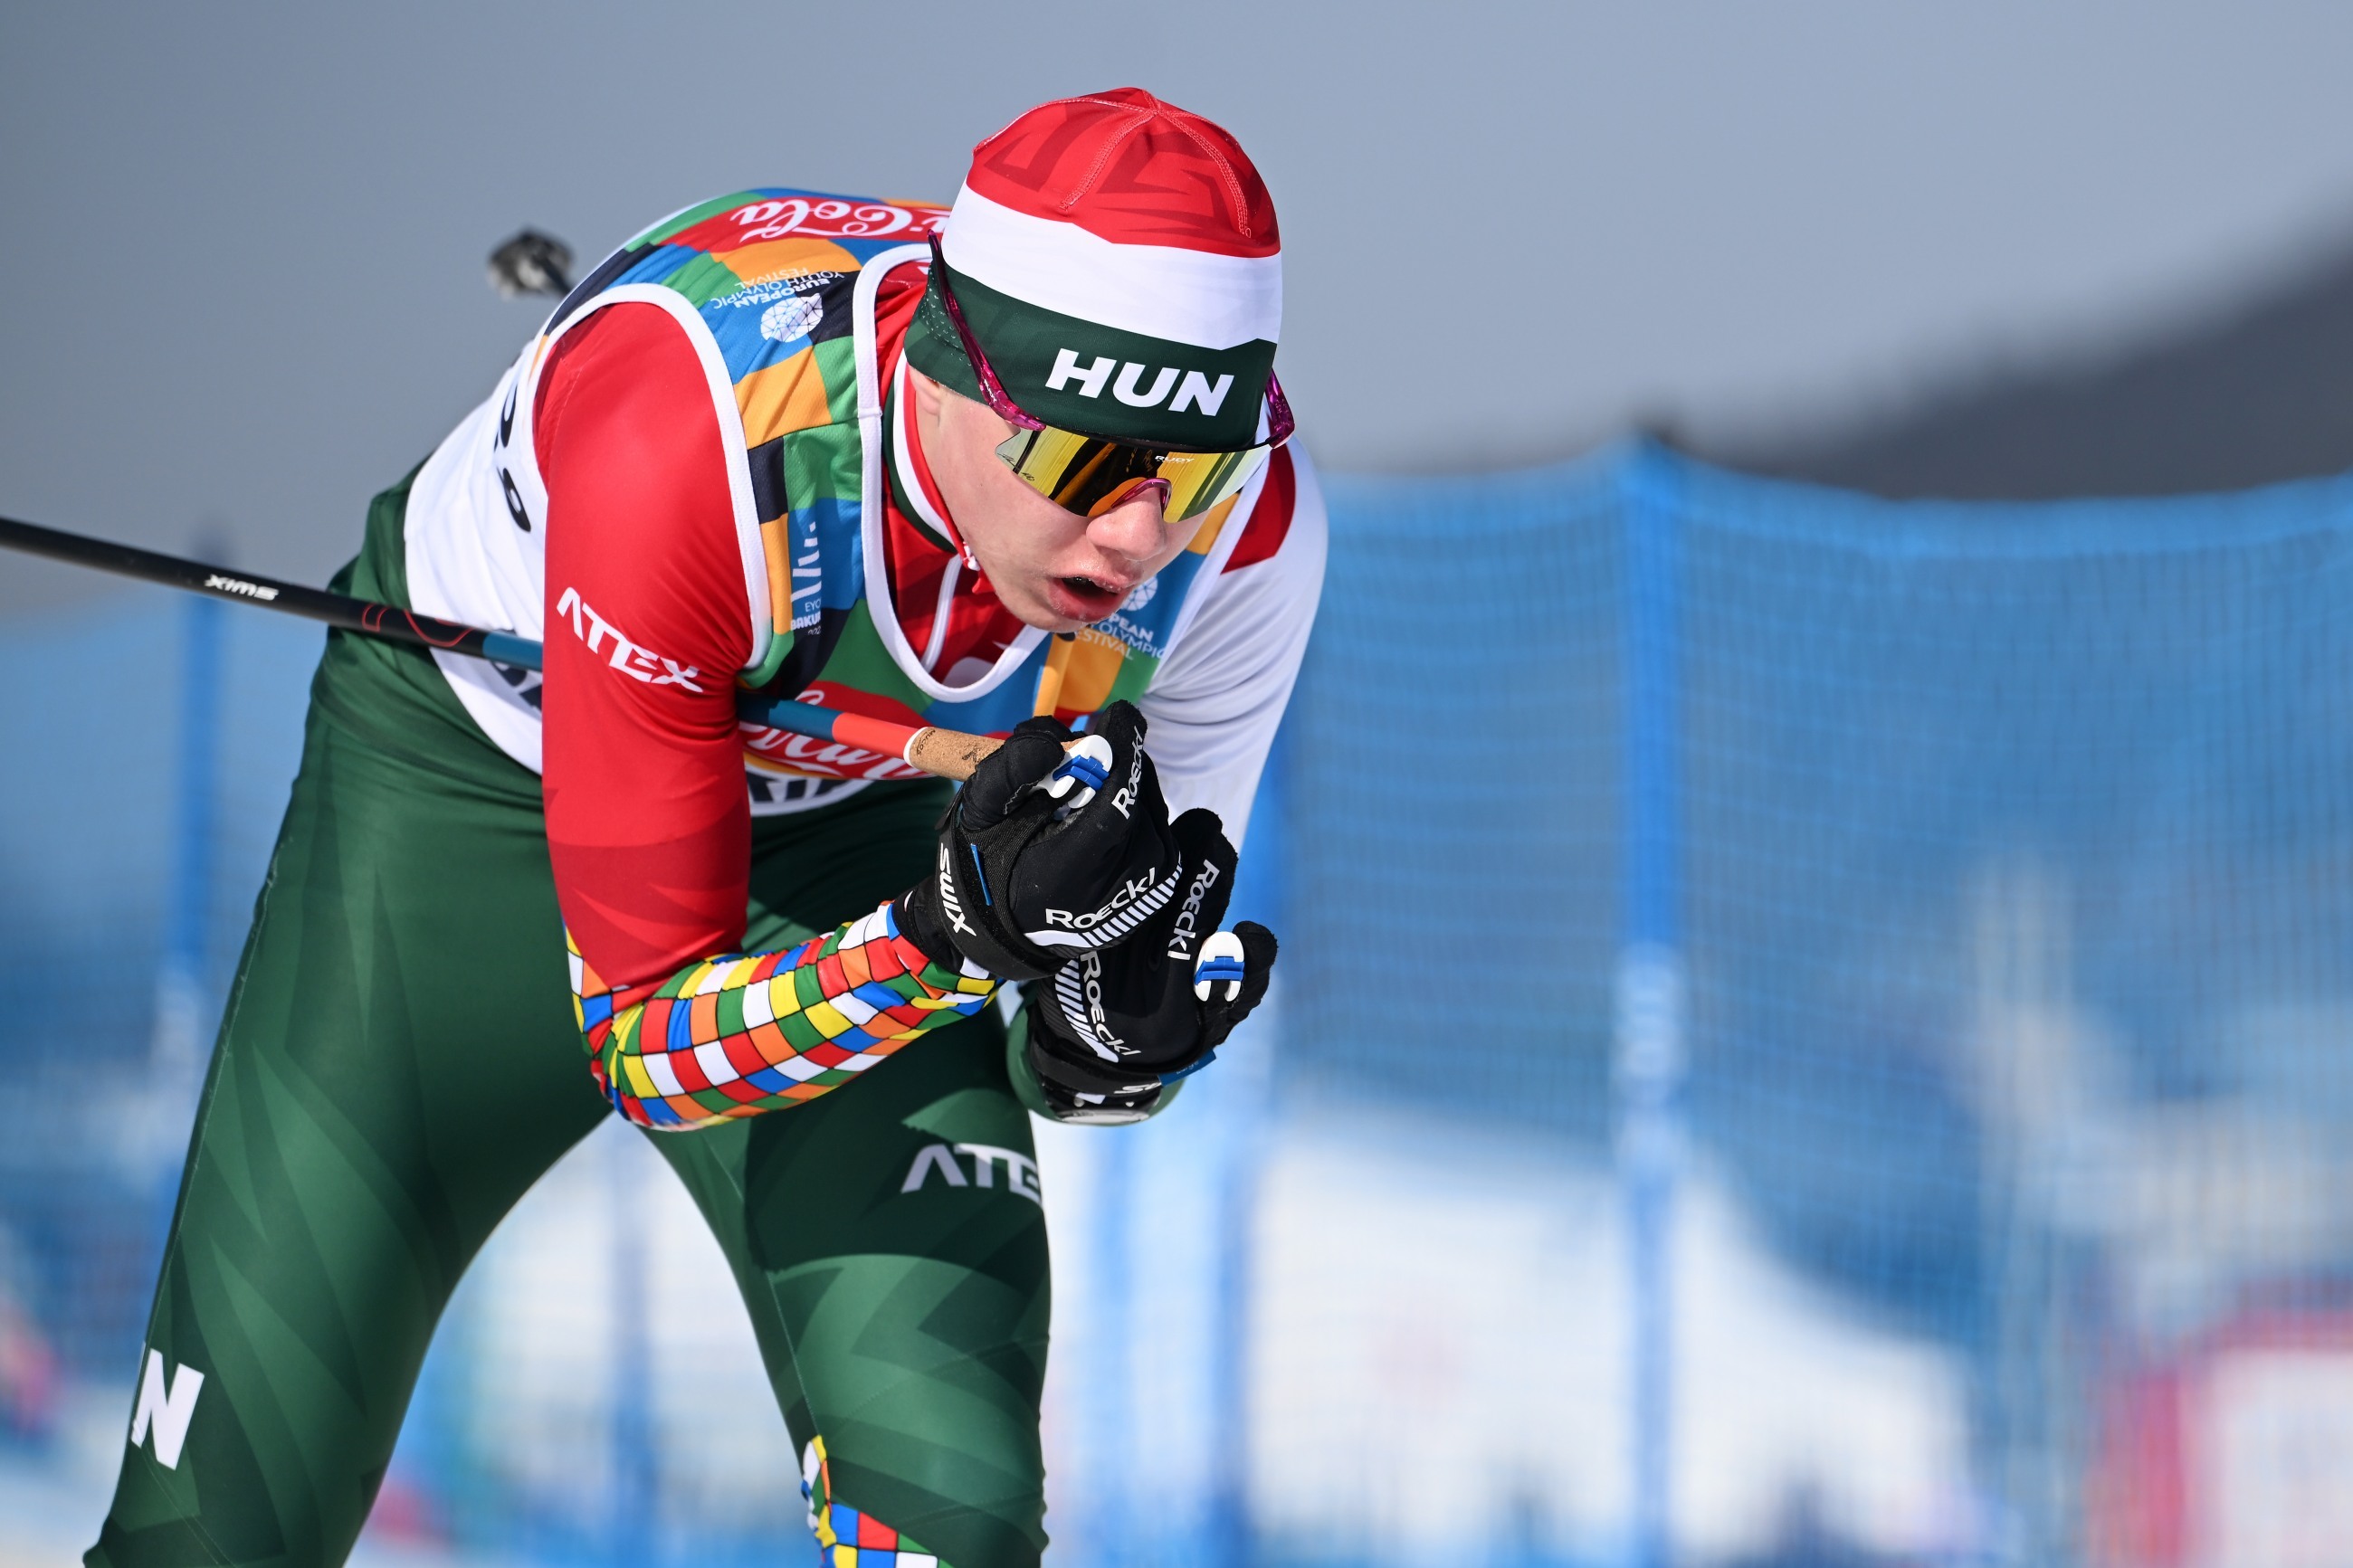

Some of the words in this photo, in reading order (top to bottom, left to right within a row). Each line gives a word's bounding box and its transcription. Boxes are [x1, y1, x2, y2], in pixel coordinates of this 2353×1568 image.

[735, 267, 808, 290] FESTIVAL
[787, 271, 845, 288] YOUTH
[710, 280, 783, 309] OLYMPIC
[734, 278, 831, 309] EUROPEAN
[1045, 347, 1234, 416] HUN
[805, 598, 822, 613] EYO
[790, 611, 822, 631] BAKU
[1109, 613, 1154, 642] PEAN
[557, 586, 703, 693] ATEX
[900, 1143, 1043, 1210] ATE
[131, 1347, 205, 1470] N
